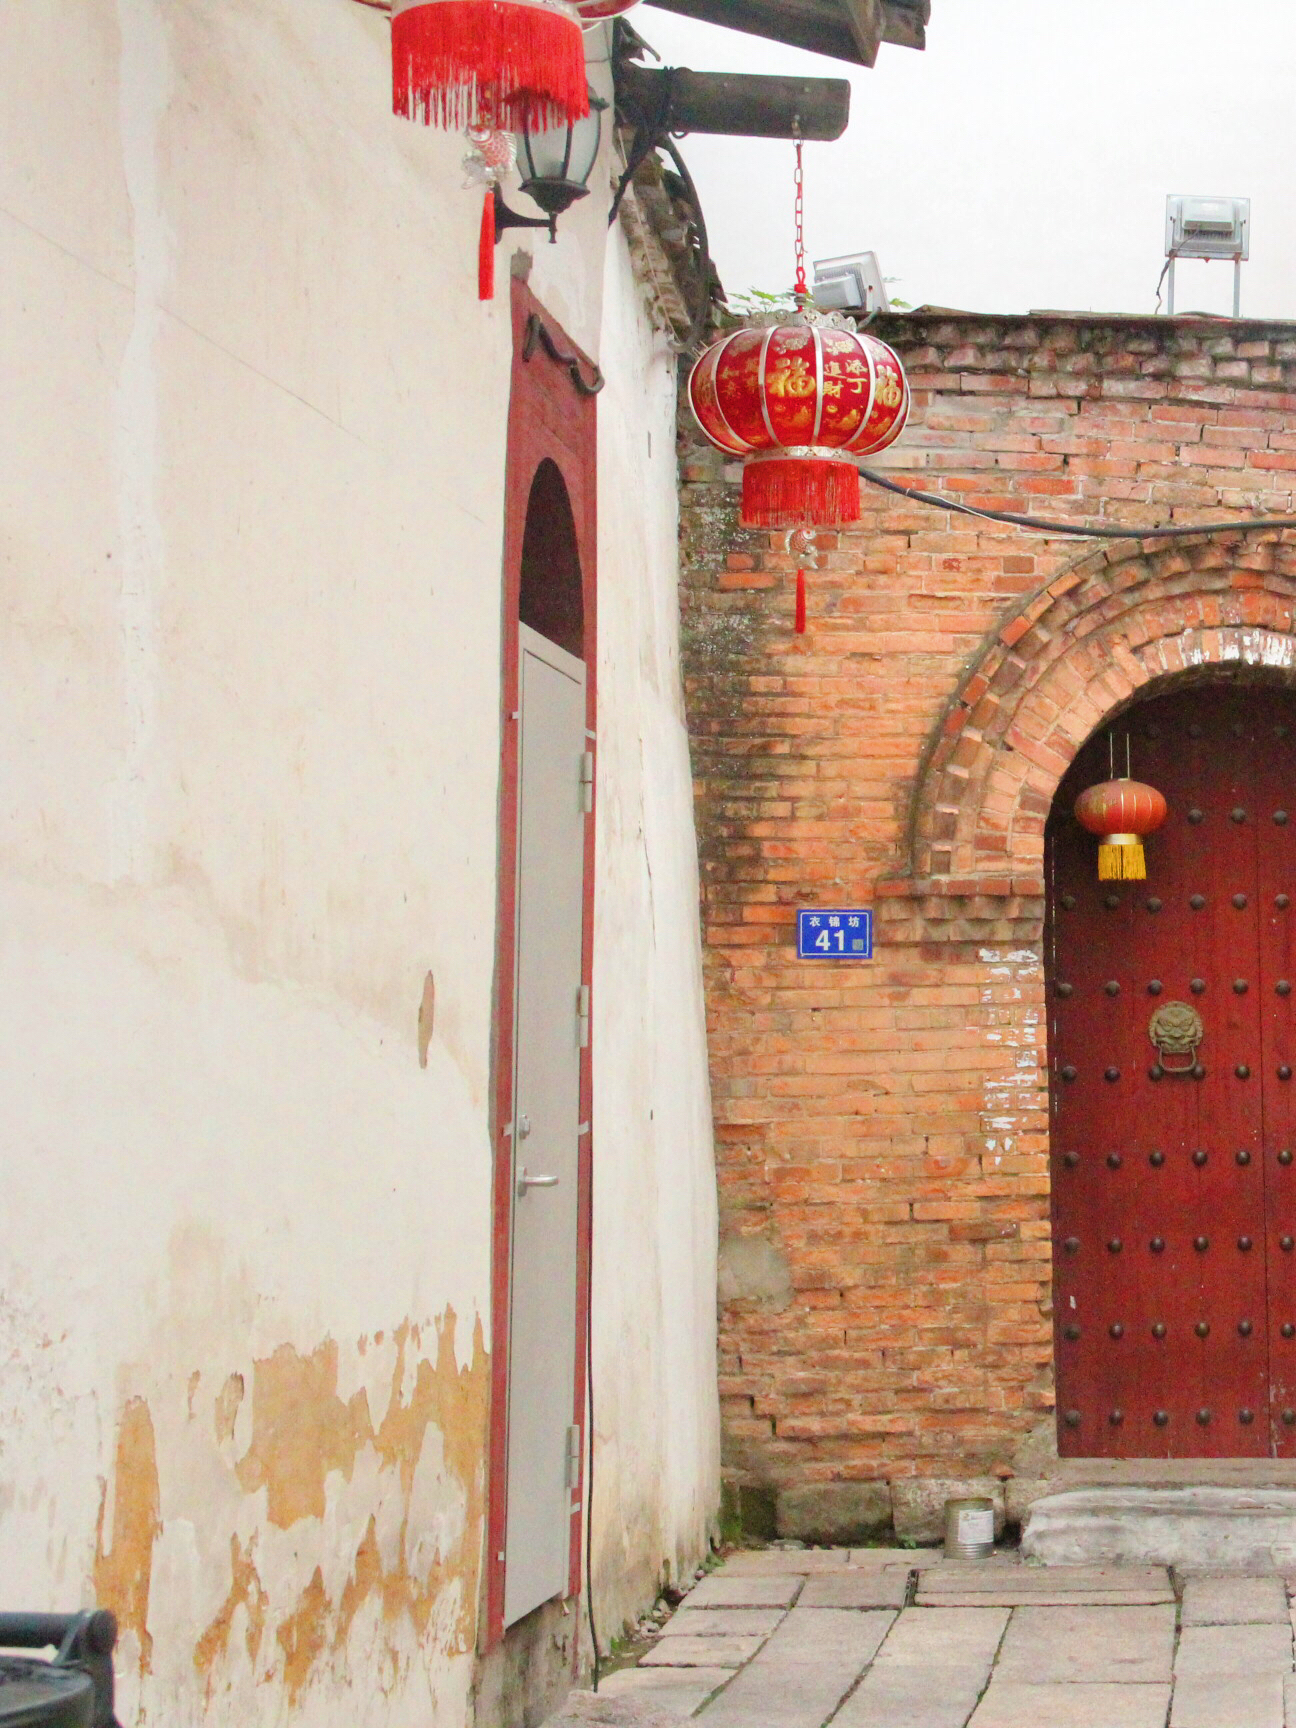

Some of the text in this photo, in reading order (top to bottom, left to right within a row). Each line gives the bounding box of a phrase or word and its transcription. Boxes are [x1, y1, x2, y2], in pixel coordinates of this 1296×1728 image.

[766, 356, 816, 397] 福
[809, 916, 860, 928] 衣锦坊
[815, 929, 845, 951] 41
